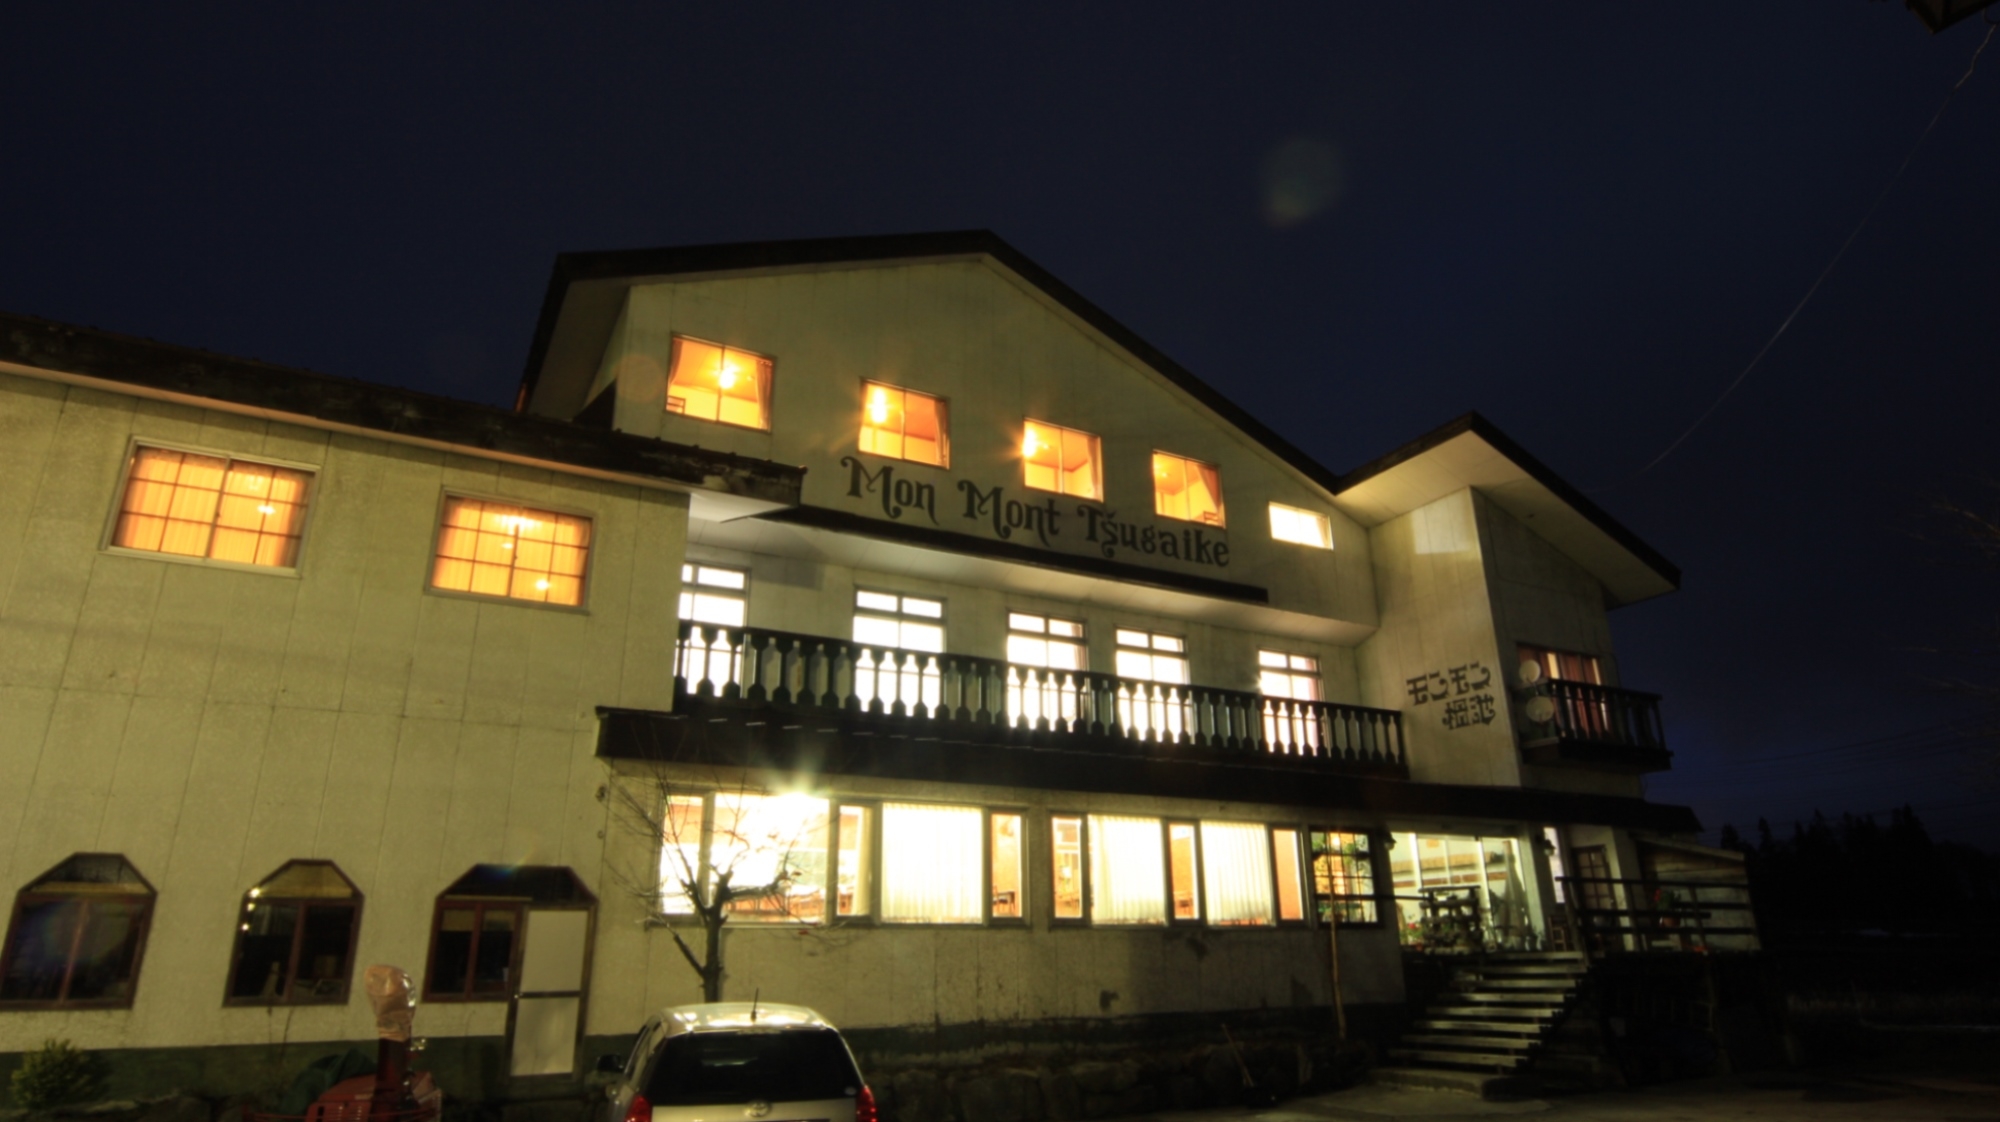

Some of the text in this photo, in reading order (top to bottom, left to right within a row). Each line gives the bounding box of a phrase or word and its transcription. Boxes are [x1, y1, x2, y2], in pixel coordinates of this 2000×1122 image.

[840, 456, 940, 526] Mon
[957, 479, 1061, 547] Mont
[1406, 661, 1491, 706] モンモン
